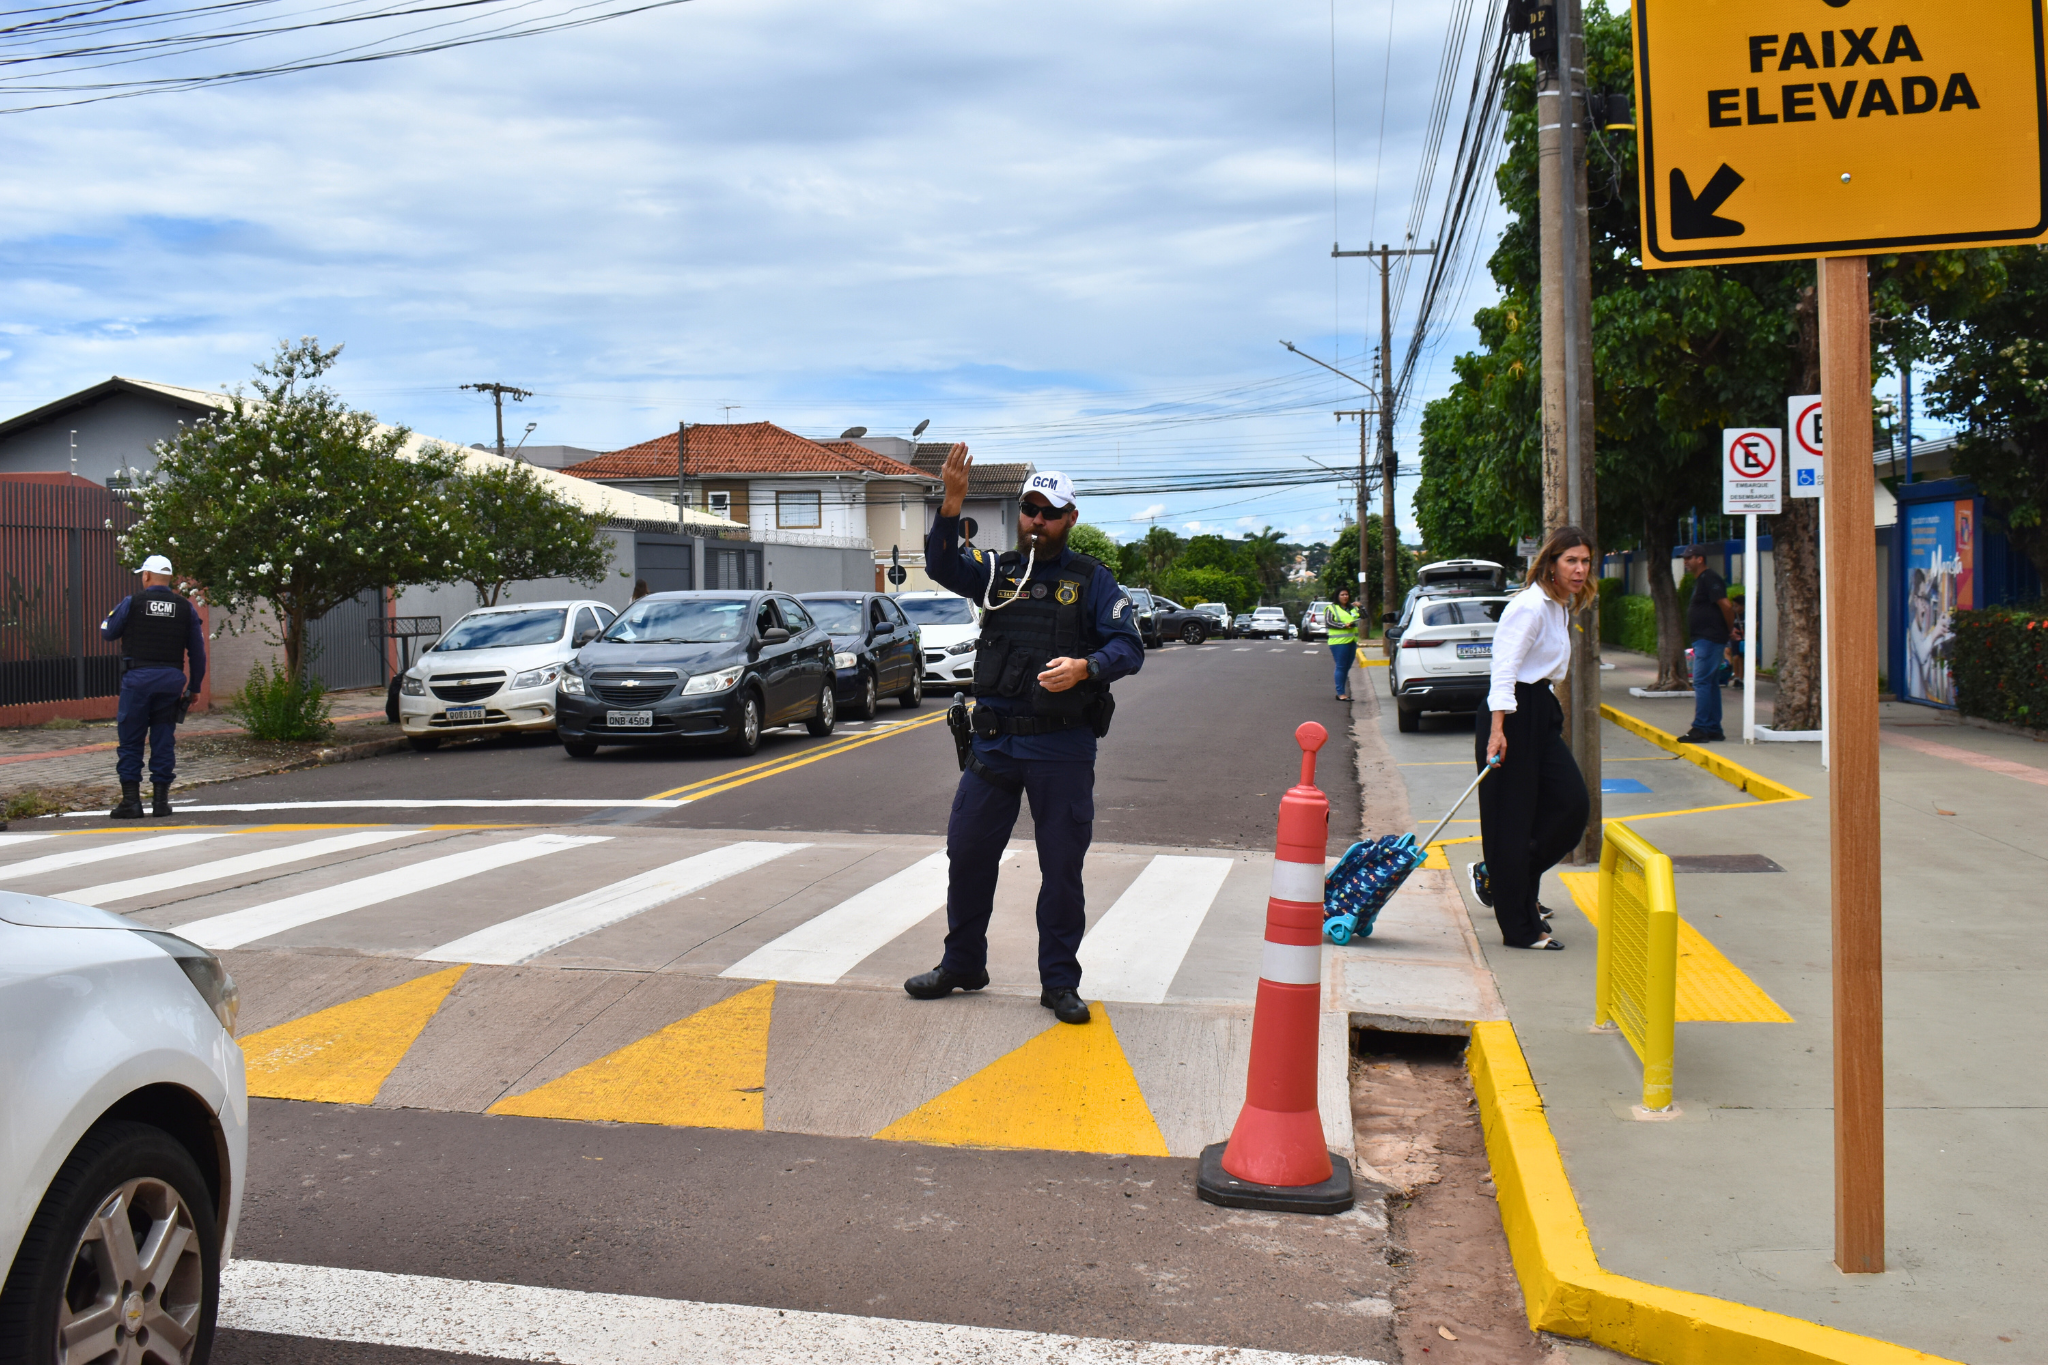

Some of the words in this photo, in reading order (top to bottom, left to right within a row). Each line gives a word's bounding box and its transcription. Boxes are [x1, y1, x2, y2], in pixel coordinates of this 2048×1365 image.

[1530, 10, 1546, 24] DF
[1532, 26, 1546, 40] 13
[1748, 24, 1924, 73] FAIXA
[1707, 72, 1981, 128] ELEVADA
[1032, 475, 1058, 491] GCM
[1931, 544, 1963, 582] Marista
[150, 602, 172, 613] GCM
